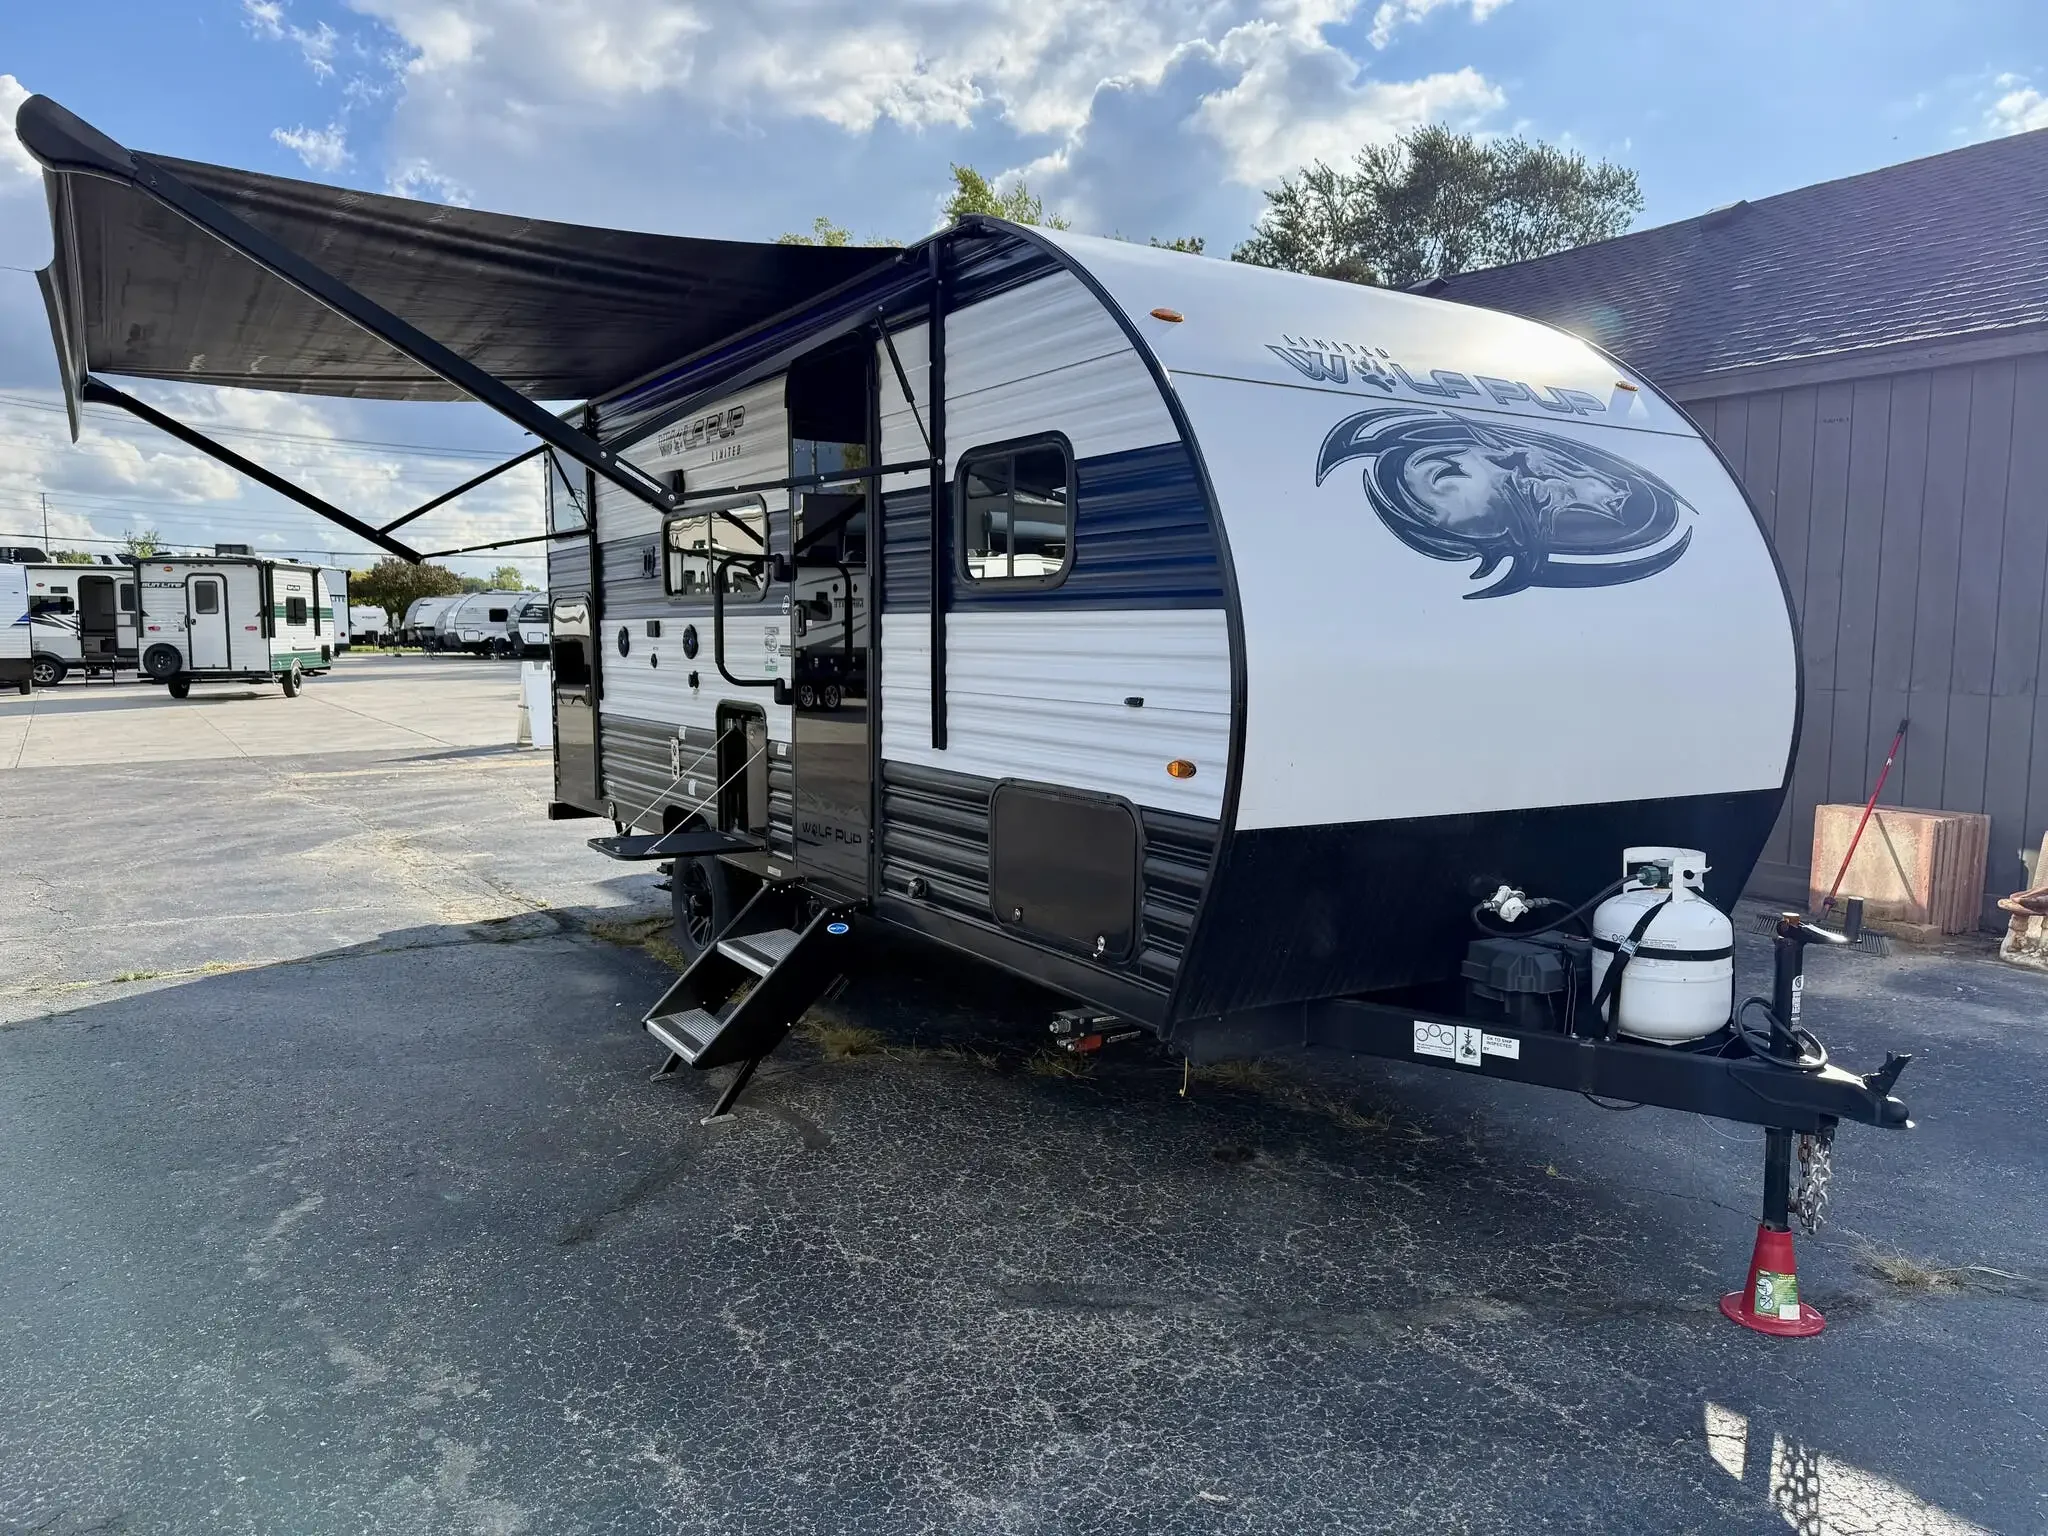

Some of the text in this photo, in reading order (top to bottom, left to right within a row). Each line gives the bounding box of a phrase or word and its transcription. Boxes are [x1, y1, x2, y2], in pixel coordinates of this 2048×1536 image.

[1283, 334, 1390, 359] LIMITED
[1473, 374, 1607, 416] PUP
[711, 445, 741, 461] LIMITED
[835, 828, 862, 844] PUP
